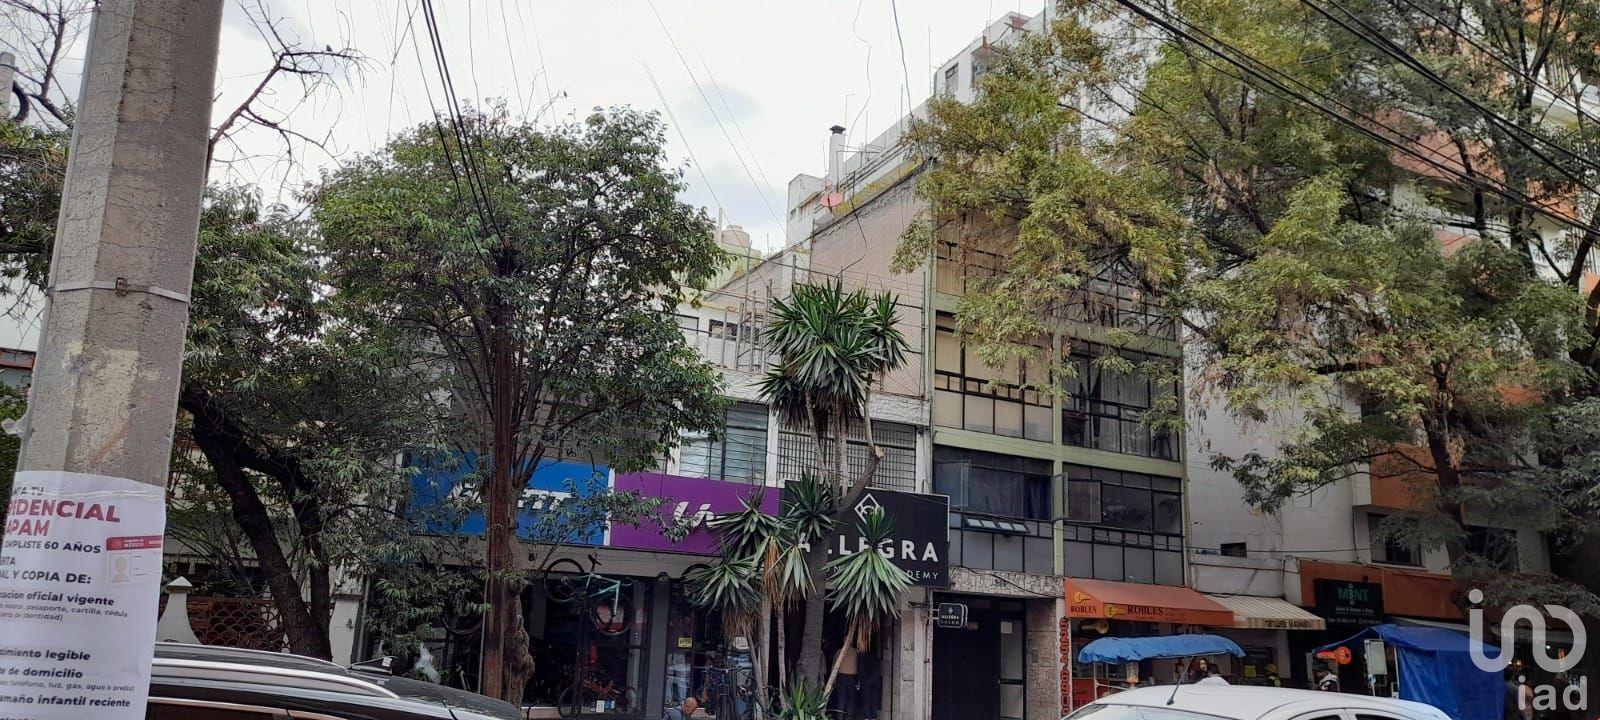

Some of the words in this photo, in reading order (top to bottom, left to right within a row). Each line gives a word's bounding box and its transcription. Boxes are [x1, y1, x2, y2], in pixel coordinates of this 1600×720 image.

[44, 541, 59, 550] 60
[62, 541, 101, 554] AÑOS
[798, 532, 939, 562] ALEGRA
[13, 570, 20, 579] Y
[21, 570, 60, 582] COPIA
[65, 573, 92, 584] DE:
[26, 591, 63, 602] oficial
[66, 594, 114, 606] vigente
[1070, 605, 1097, 614] ROBLES
[1127, 605, 1164, 615] ROBLES
[45, 650, 91, 661] legible
[23, 667, 84, 679] domicilio
[37, 694, 87, 705] infantil
[89, 697, 131, 707] reciente
